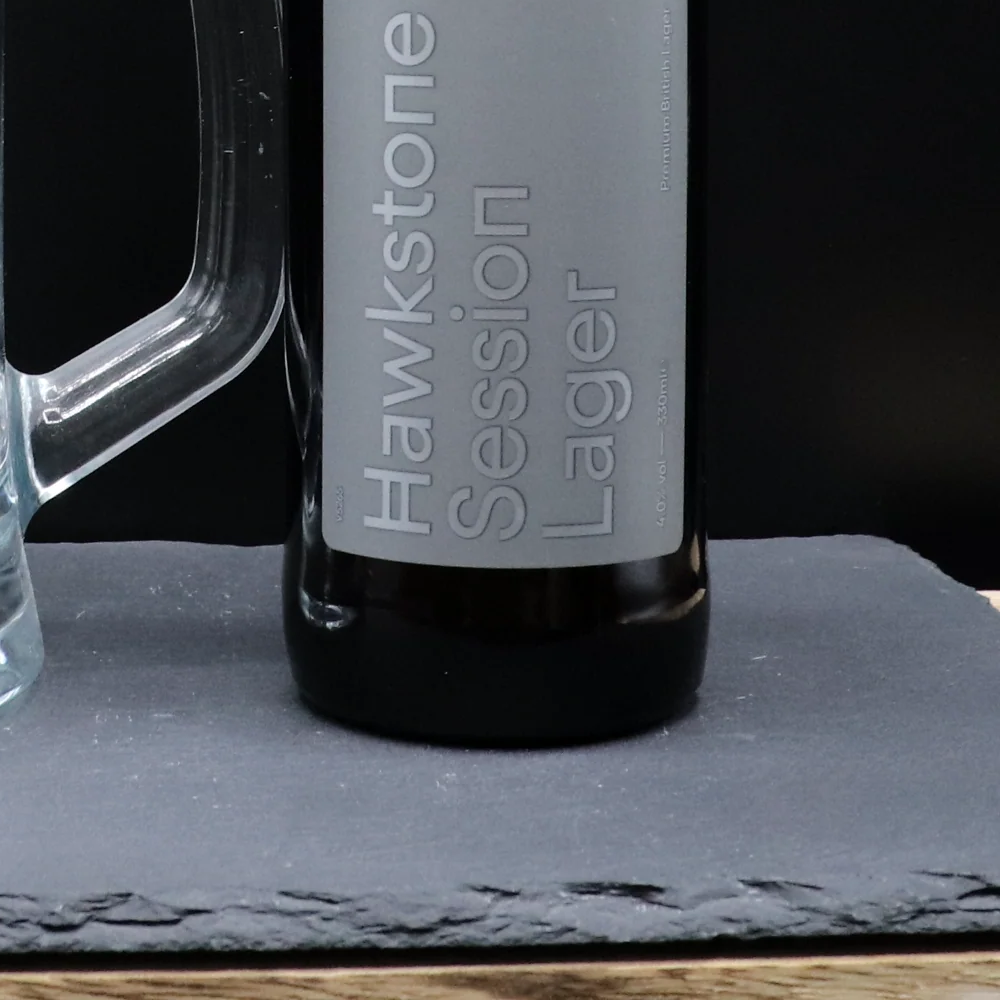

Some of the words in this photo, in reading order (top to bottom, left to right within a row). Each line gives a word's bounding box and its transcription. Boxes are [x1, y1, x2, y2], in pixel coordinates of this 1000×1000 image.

[660, 8, 673, 56] Lager
[659, 60, 672, 112] British
[659, 116, 672, 192] Premium
[362, 11, 437, 536] Hawkstone
[447, 185, 530, 542] Session
[541, 269, 633, 540] Lager
[656, 459, 667, 485] vol
